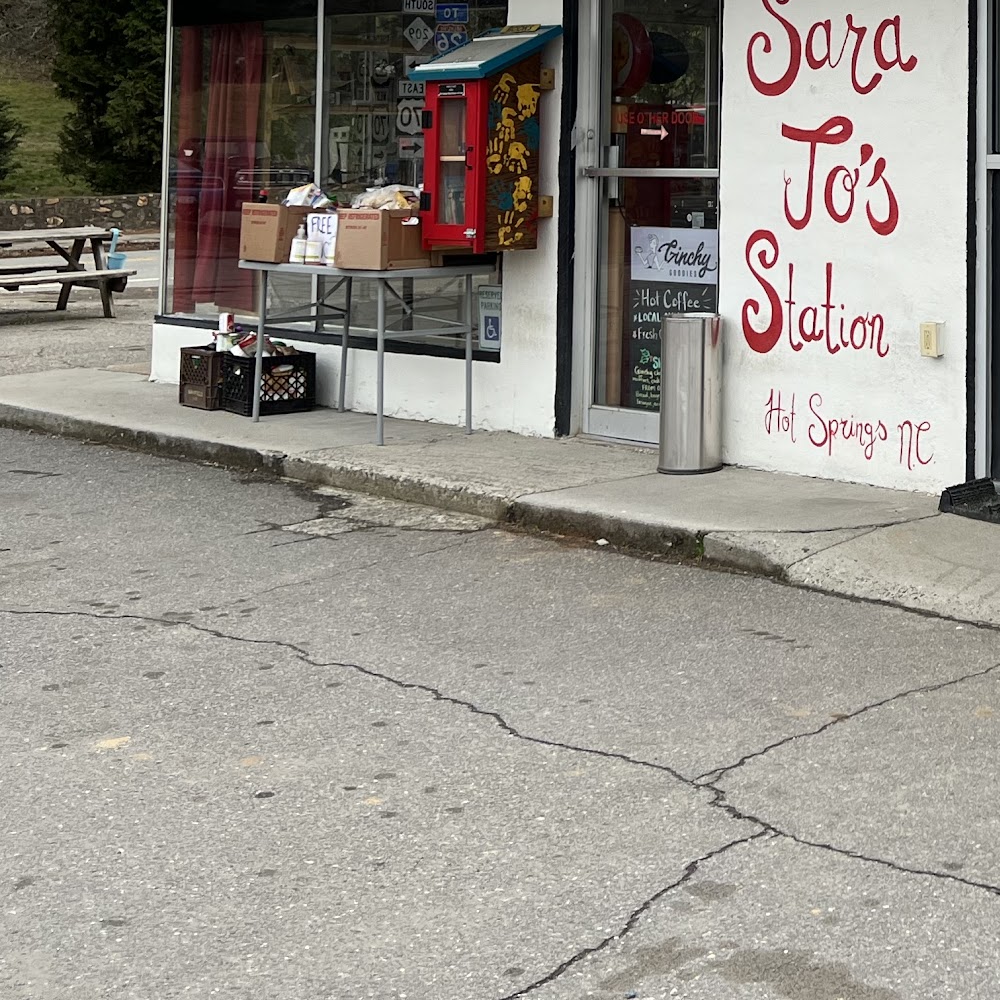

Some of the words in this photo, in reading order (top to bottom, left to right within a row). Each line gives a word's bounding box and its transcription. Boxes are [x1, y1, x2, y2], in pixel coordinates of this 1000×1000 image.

[615, 112, 635, 124] USE
[637, 112, 669, 124] OTHER
[781, 115, 899, 236] Jo's
[311, 216, 333, 234] FREE
[669, 269, 698, 278] GOODIES
[641, 289, 660, 307] Hot
[663, 289, 701, 311] Coffee
[741, 229, 889, 357] Station
[765, 388, 797, 443] Hot
[808, 393, 888, 460] Springs
